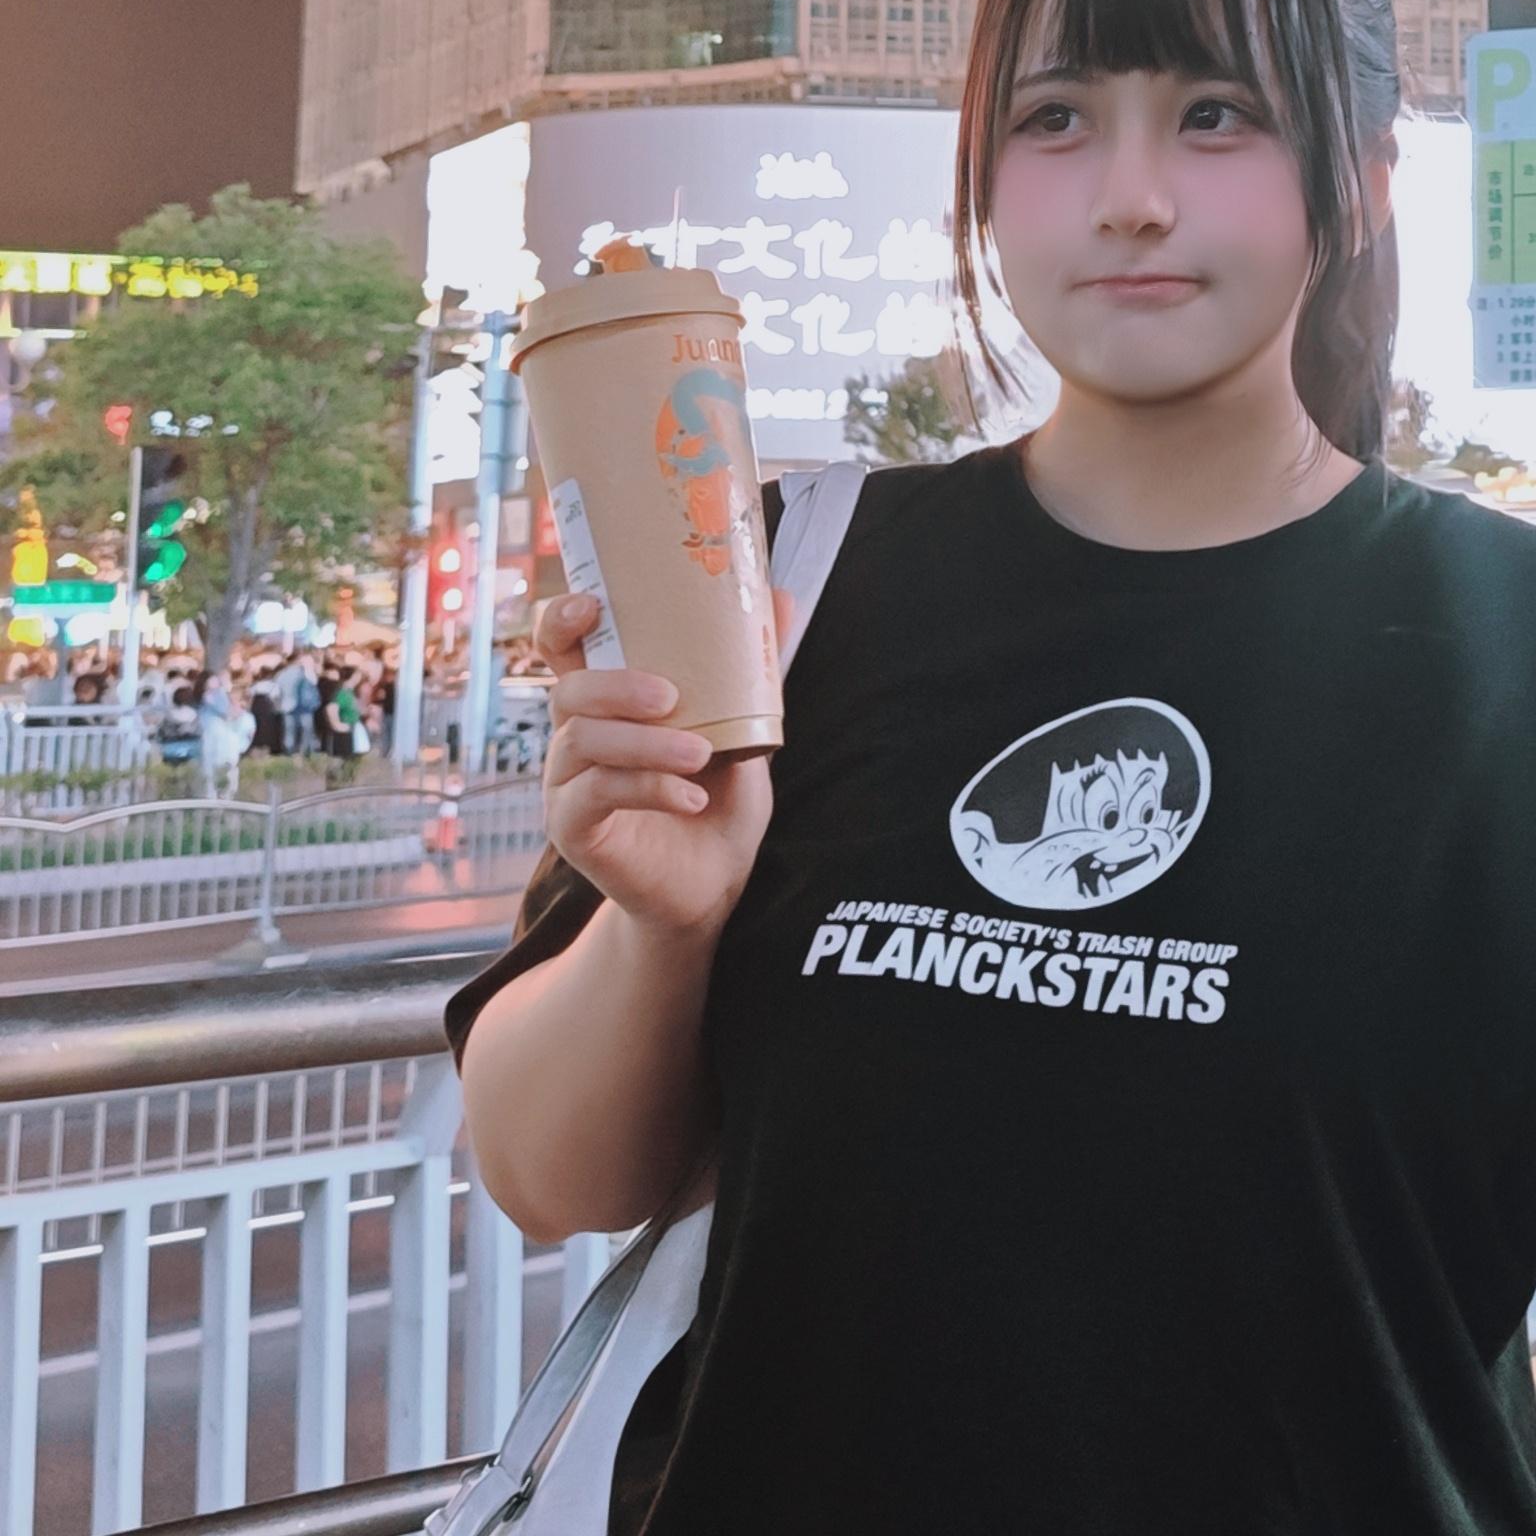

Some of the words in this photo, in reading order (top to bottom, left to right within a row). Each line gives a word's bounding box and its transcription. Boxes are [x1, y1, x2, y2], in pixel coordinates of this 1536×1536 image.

[1476, 48, 1531, 133] P
[802, 924, 1229, 1024] PLANCKSTARS
[826, 901, 948, 928] JAPANESE
[951, 913, 1072, 949] SOCIETY'S
[1077, 932, 1154, 957] TRASH
[1158, 939, 1238, 965] GROUP
